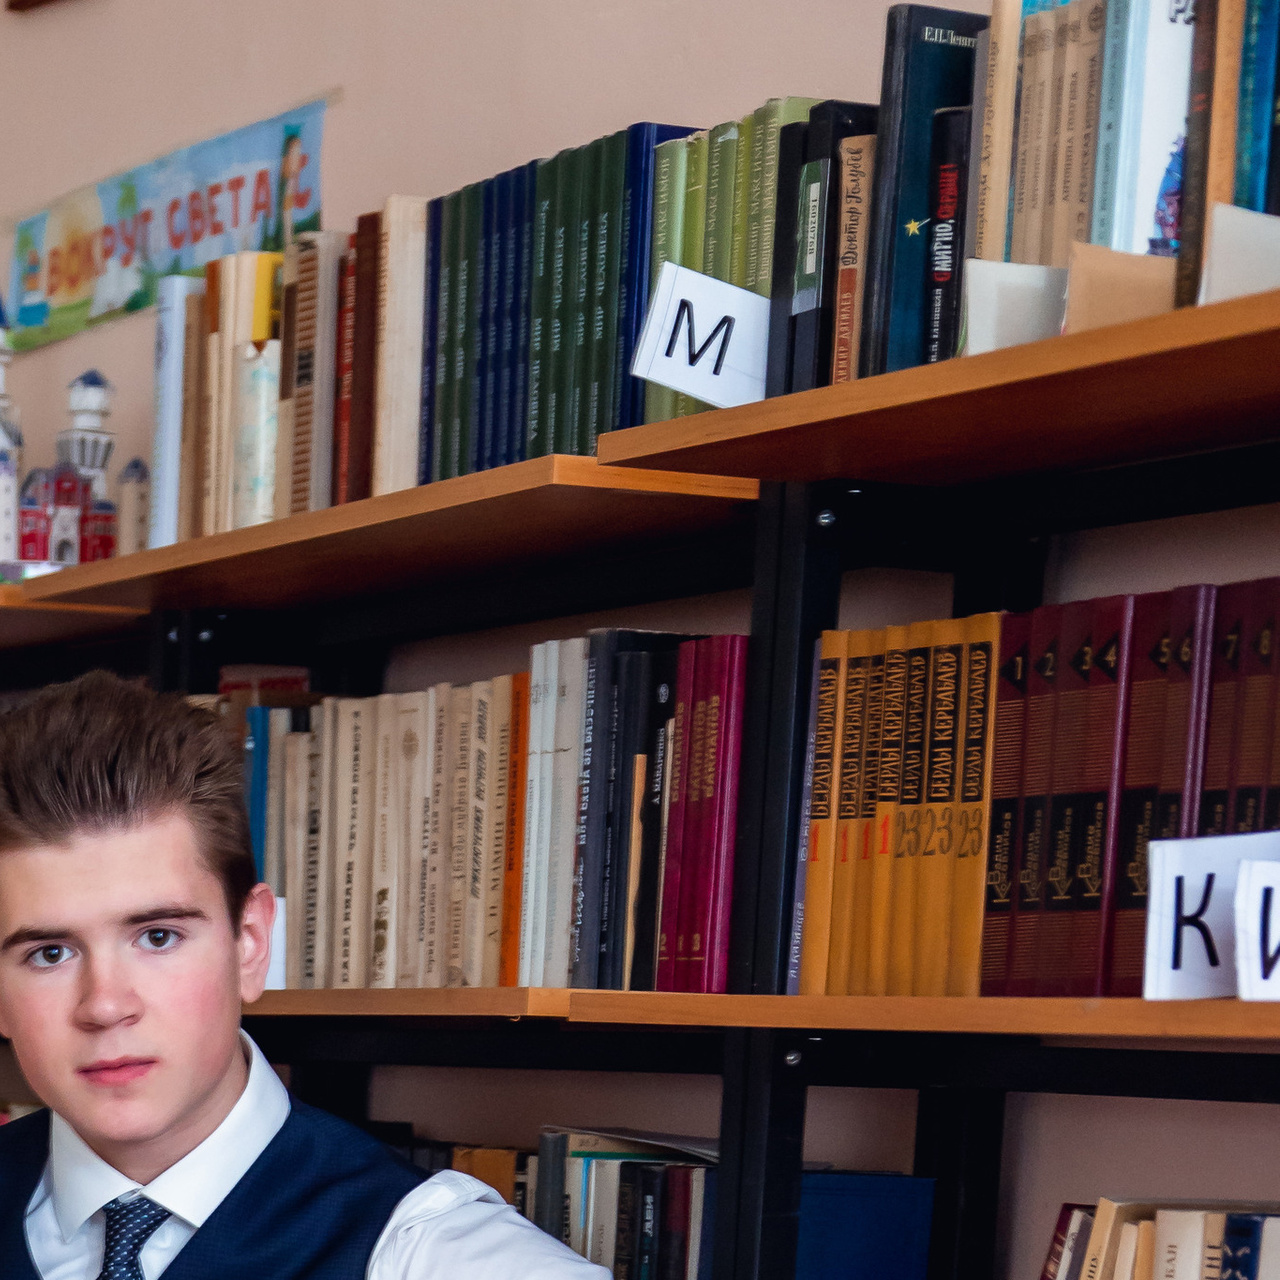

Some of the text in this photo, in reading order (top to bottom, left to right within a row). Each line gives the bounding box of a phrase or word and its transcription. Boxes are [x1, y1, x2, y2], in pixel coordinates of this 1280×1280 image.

[166, 169, 272, 251] СВЕТА
[657, 158, 670, 245] МАКСИМОВ
[746, 124, 763, 287] Владимир МАКСИМОВ
[758, 118, 777, 280] Владимир МАКСИМОВ
[842, 148, 865, 265] Доктор Голубев
[595, 212, 608, 339] МИР ЧЕЛОВЕКА
[932, 219, 955, 281] СМИРНО,
[552, 227, 564, 351] МИР ЧЕЛОВЕКА
[577, 221, 588, 345] МИР ЧЕЛОВЕКА
[665, 299, 736, 375] М
[1013, 655, 1023, 680] 1
[1044, 651, 1055, 676] 2
[1081, 645, 1092, 670] 3
[1104, 645, 1116, 670] 4
[1159, 637, 1171, 662] 5
[1179, 637, 1191, 661] 6
[1226, 634, 1238, 660] 7
[1260, 630, 1270, 655] 8
[878, 654, 905, 797] БЕРДЫ КЕРБАБАЕВ
[814, 759, 831, 816] БЕРДЫ
[842, 760, 858, 816] БЕРДЫ
[902, 753, 920, 799] БЕРДЫ
[931, 748, 952, 797] БЕРДЫ
[964, 747, 980, 797] БЕРДЫ
[471, 806, 484, 899] ПРИКЛЮЧЕНИЯ
[1171, 872, 1219, 970] К
